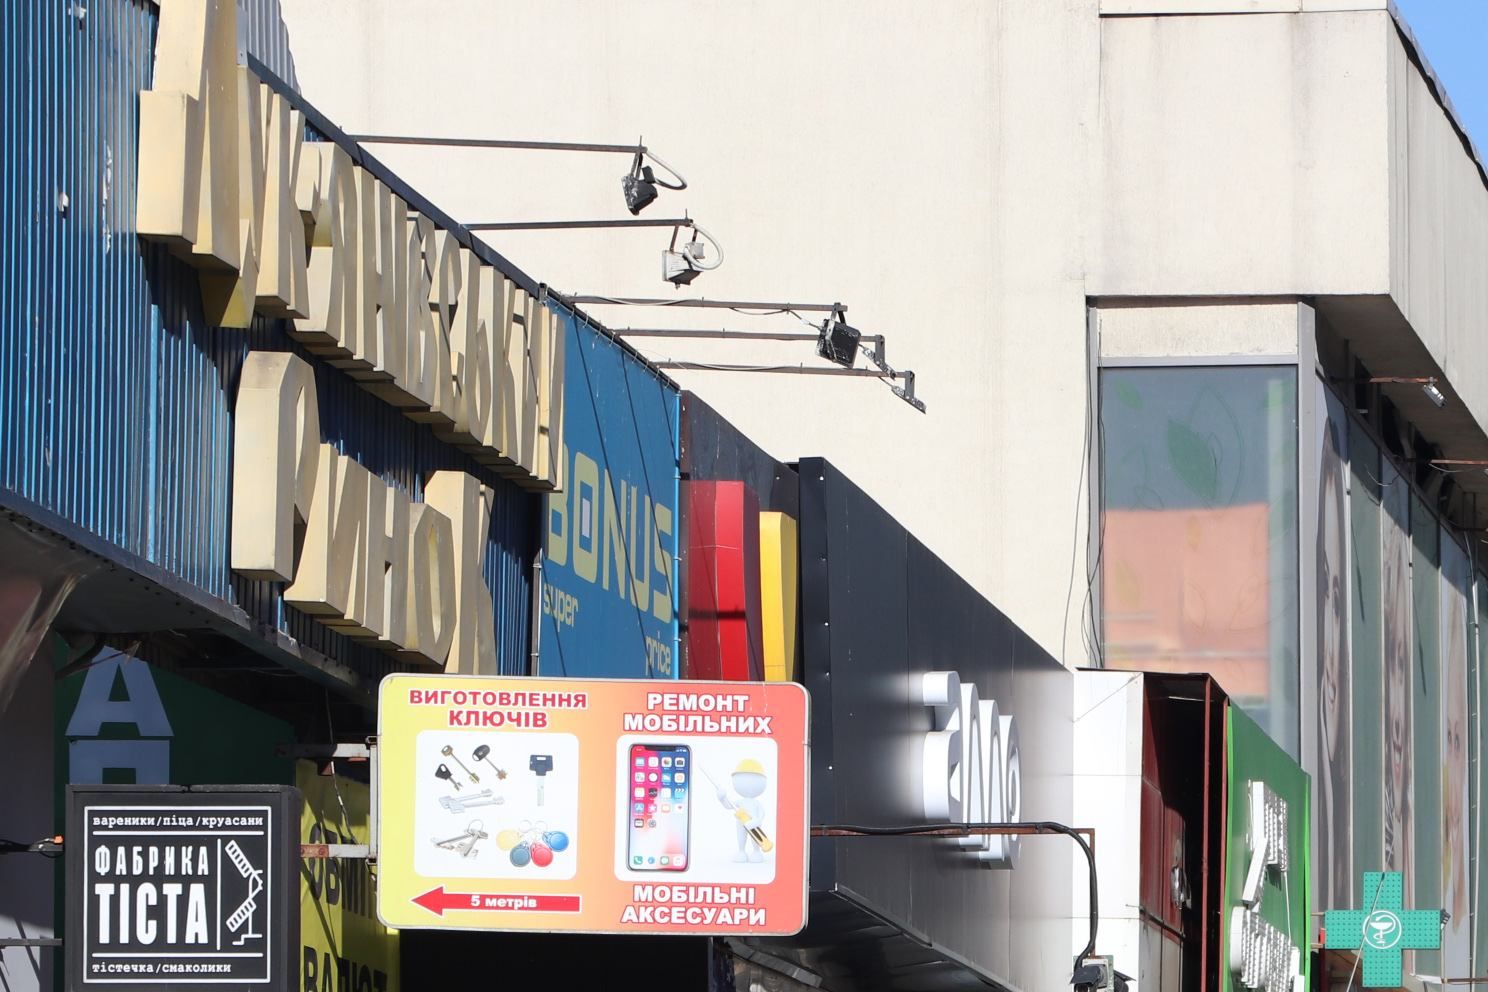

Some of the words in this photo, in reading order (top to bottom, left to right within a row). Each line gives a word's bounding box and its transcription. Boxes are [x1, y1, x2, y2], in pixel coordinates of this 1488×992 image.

[548, 443, 672, 624] BONUS
[544, 583, 578, 633] super
[645, 630, 671, 677] price
[409, 689, 587, 709] ВИГОТОВЛЕННЯ
[646, 692, 750, 713] РЕМОНТ
[448, 710, 548, 729] КЛЮЧІВ
[623, 714, 773, 735] МОБІЛЬНИХ
[95, 845, 209, 875] ФАБРИКА
[471, 894, 481, 908] 5
[485, 894, 537, 912] метрів
[633, 885, 755, 905] МОБІЛЬНІ
[95, 882, 209, 945] ТІСТА
[621, 906, 766, 926] АКСЕСУАРИ
